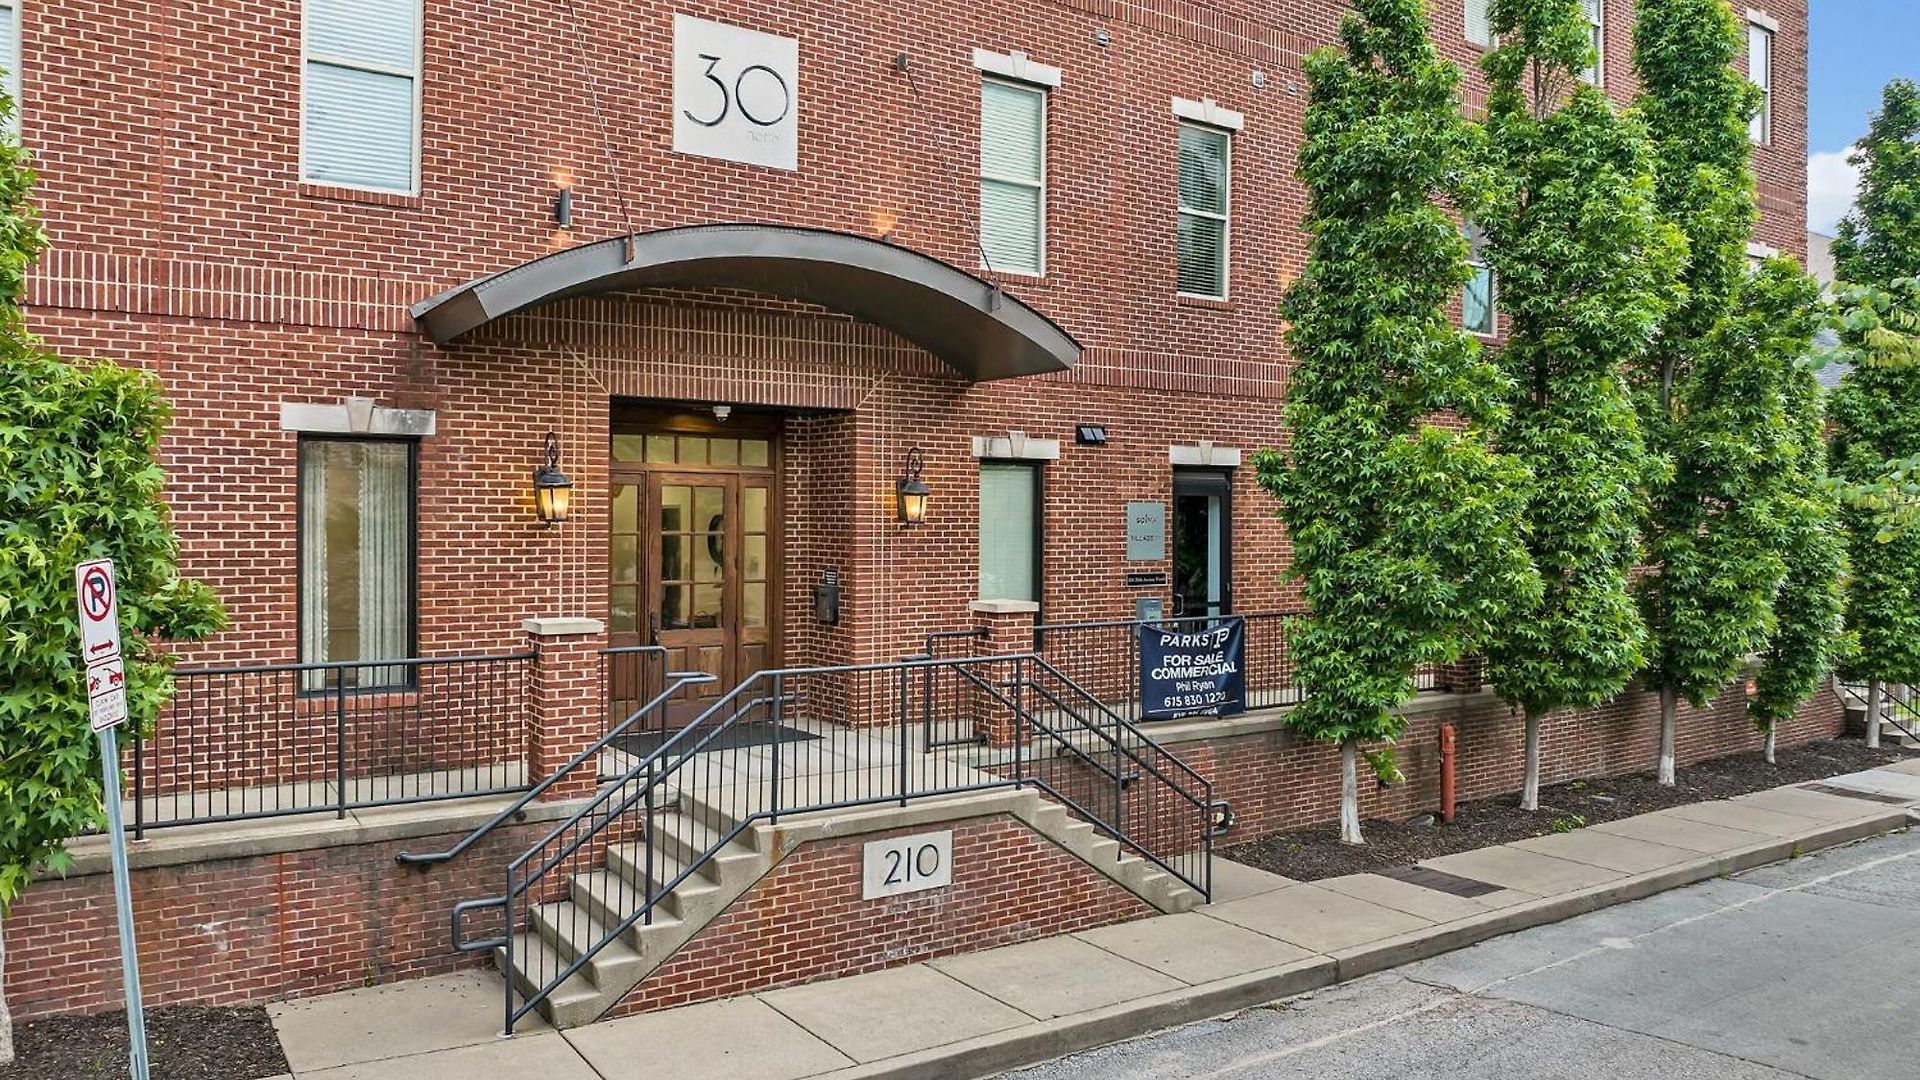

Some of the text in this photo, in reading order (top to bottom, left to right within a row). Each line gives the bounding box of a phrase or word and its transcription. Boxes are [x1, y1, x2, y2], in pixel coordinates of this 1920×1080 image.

[683, 53, 789, 127] 30
[1160, 634, 1210, 647] PARKS
[1163, 651, 1224, 667] FOR SALE
[1151, 661, 1238, 680] COMMERCIAL
[1176, 680, 1215, 692] Phil Ryan
[1164, 696, 1183, 707] 615
[1184, 694, 1203, 706] 830
[883, 844, 939, 886] 210
